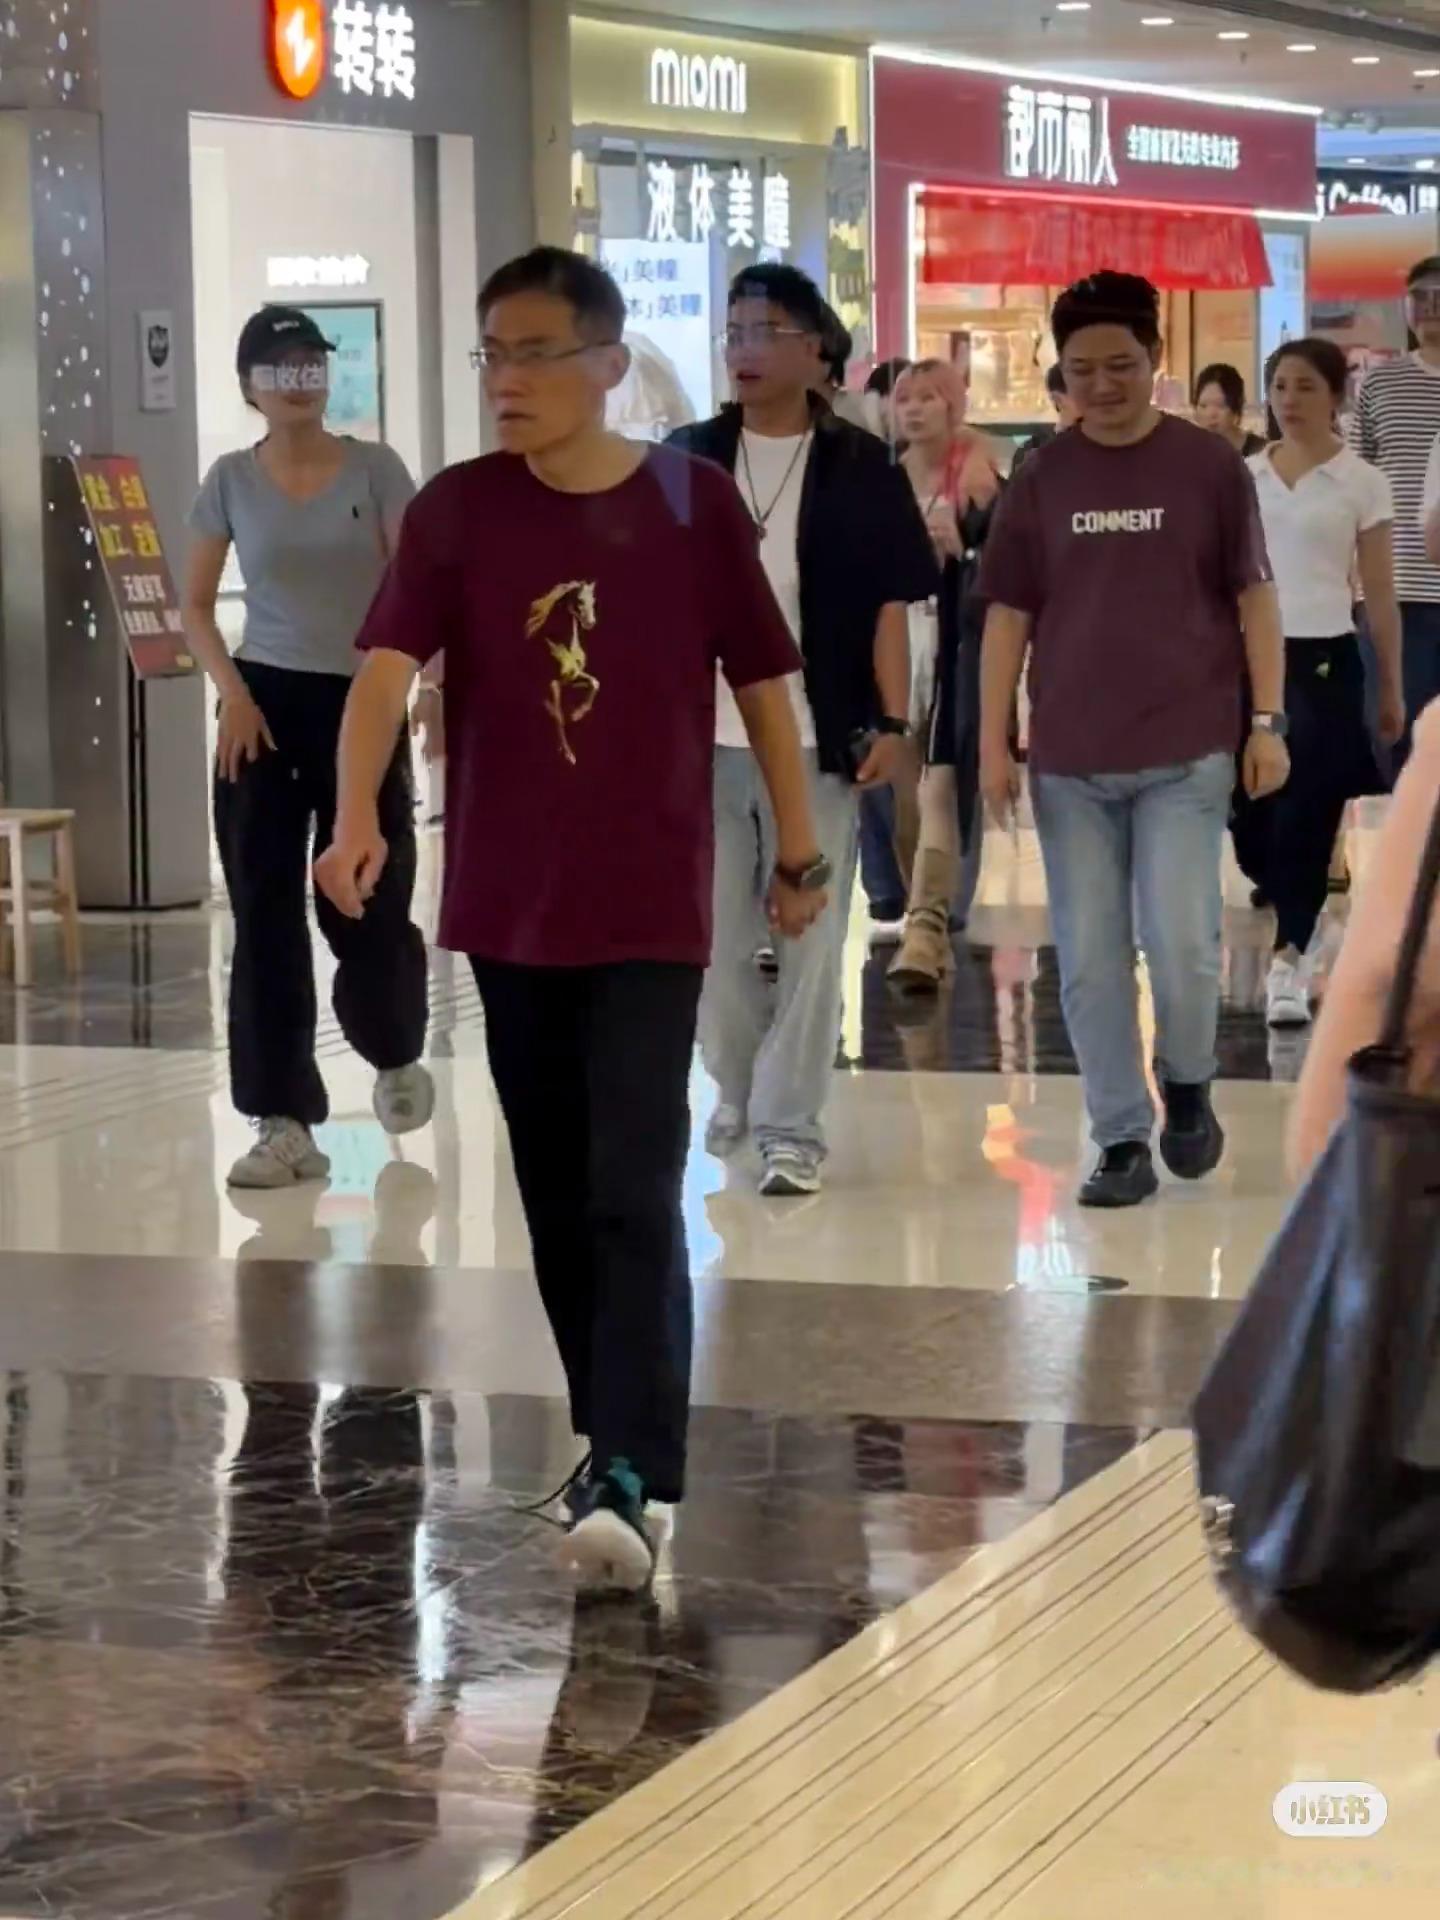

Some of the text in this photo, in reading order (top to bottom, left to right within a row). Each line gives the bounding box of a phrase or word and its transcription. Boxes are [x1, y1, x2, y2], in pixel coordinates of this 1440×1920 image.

[331, 0, 416, 101] 转转
[650, 47, 747, 113] miomi
[1007, 84, 1118, 186] 都市丽人
[647, 160, 791, 249] 液体美瞳
[1071, 507, 1165, 534] COMMENT
